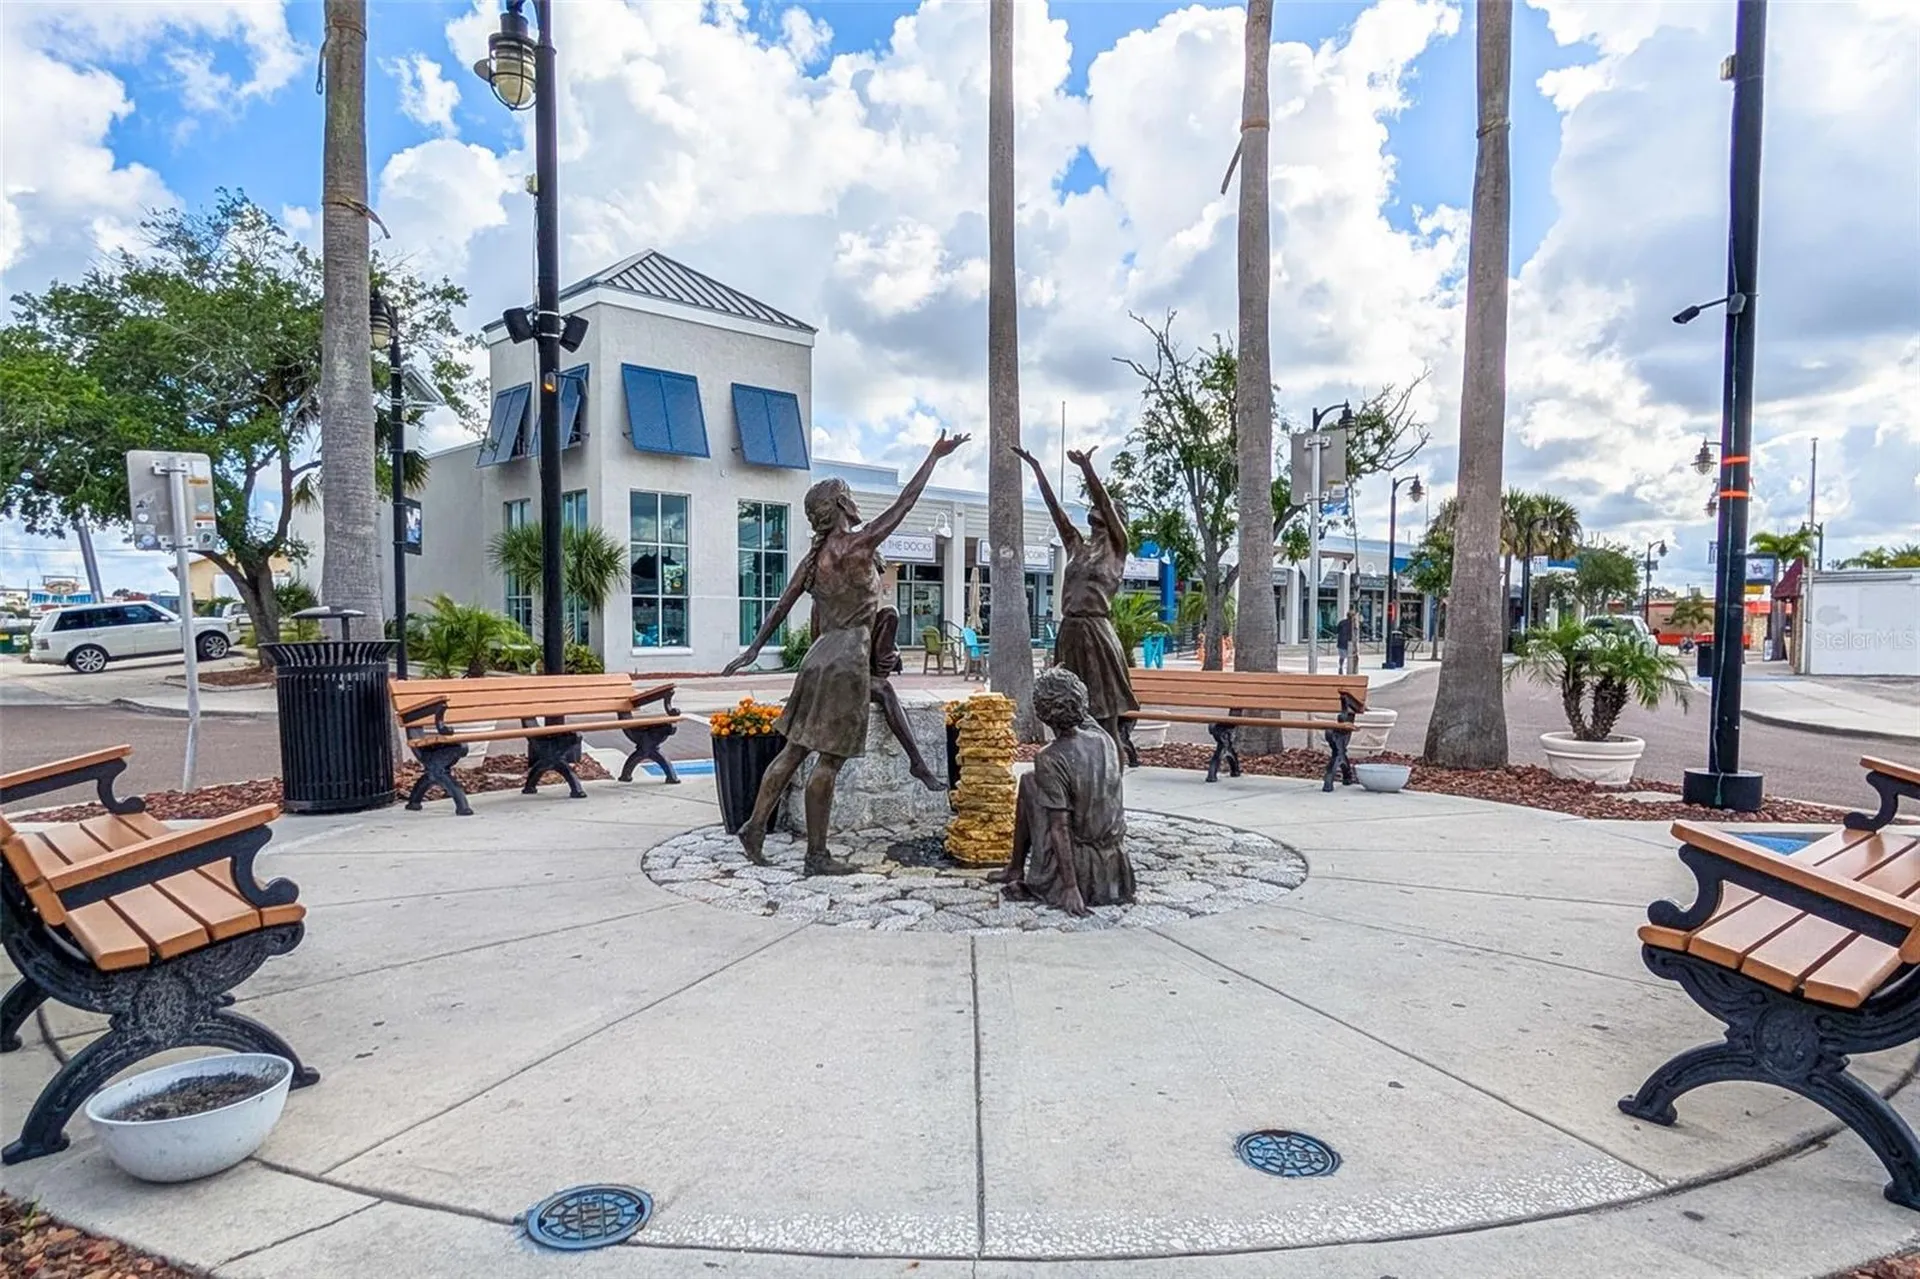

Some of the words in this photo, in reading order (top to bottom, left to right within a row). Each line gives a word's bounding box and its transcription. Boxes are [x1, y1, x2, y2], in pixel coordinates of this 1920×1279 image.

[887, 539, 903, 551] THE
[903, 541, 932, 552] DOCKS
[1248, 1147, 1325, 1163] WATER
